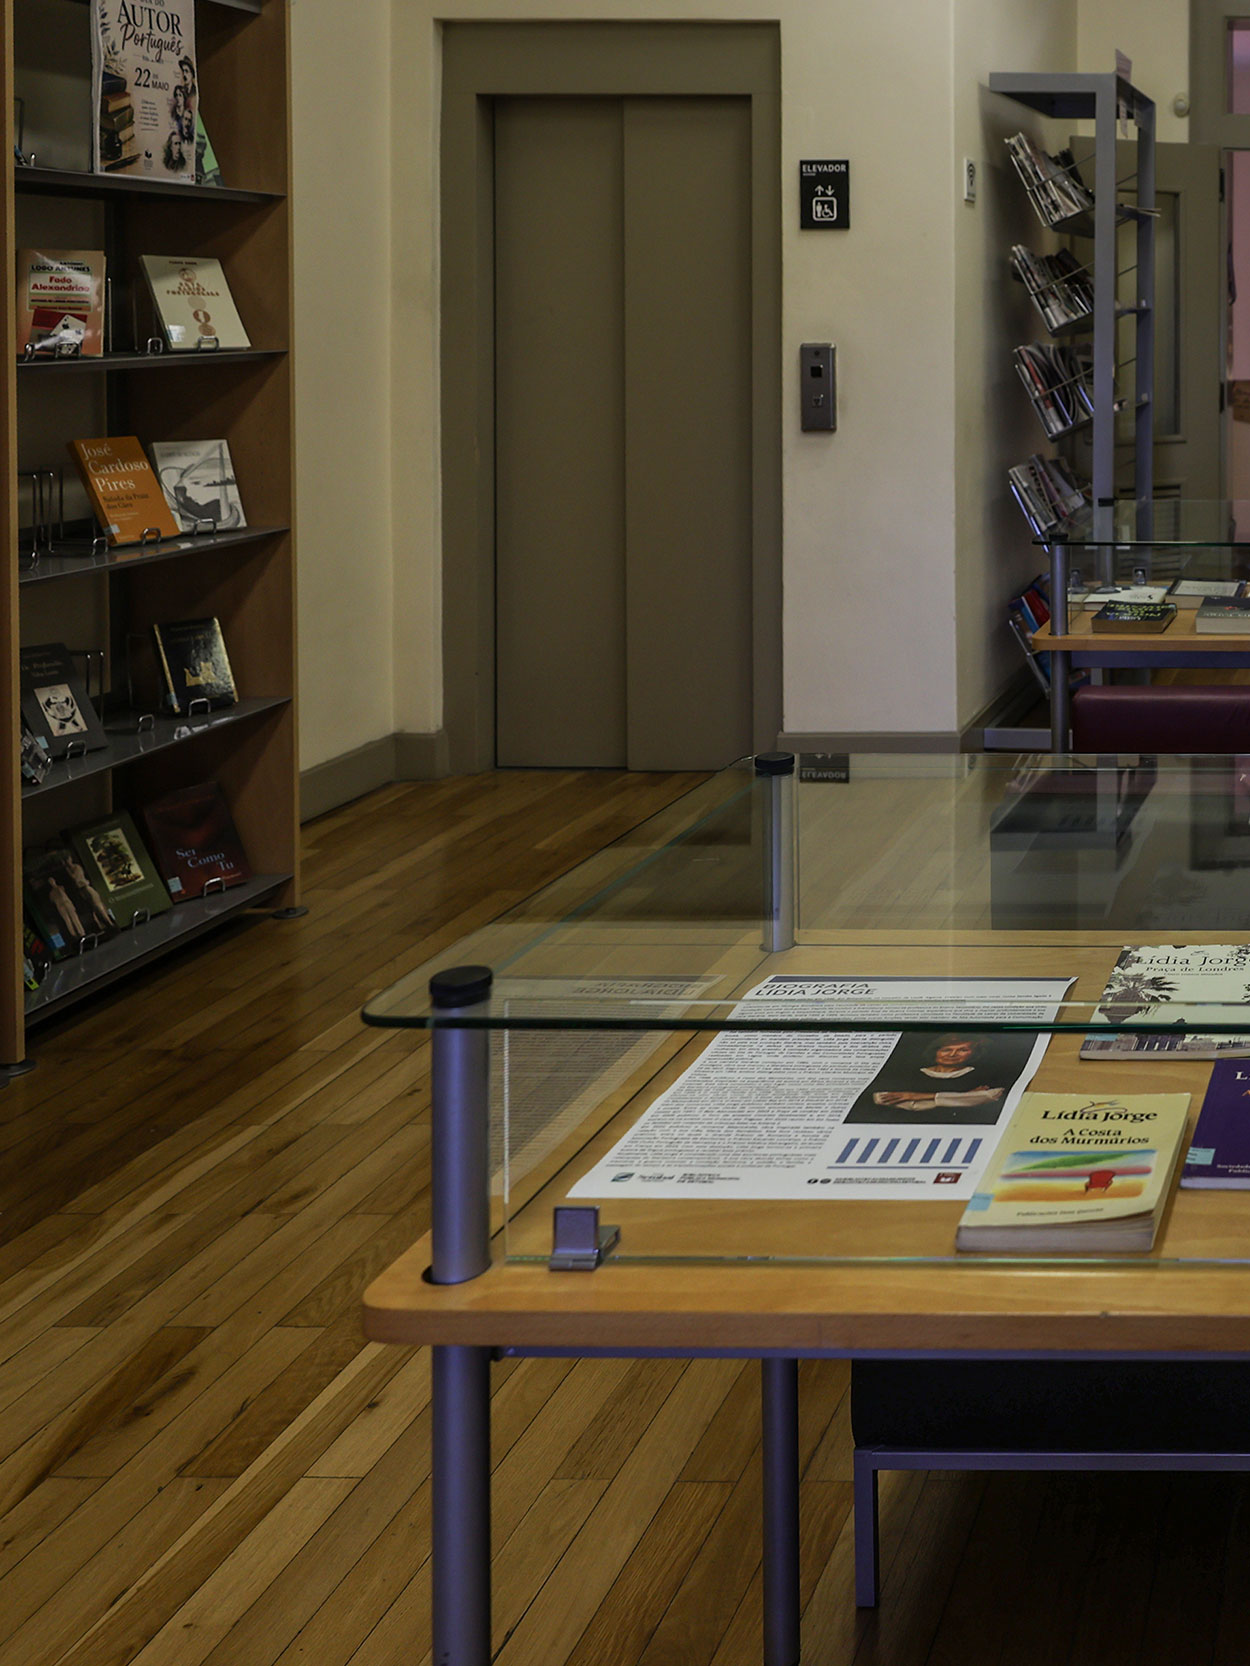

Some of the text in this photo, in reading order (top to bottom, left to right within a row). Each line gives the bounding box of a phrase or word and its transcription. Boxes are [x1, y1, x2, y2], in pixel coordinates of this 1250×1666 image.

[117, 0, 183, 37] AUTOR
[120, 23, 184, 61] Português
[134, 67, 151, 88] 22
[151, 80, 170, 91] MAIO
[802, 163, 847, 173] ELEVADOR
[49, 275, 73, 283] Fado
[31, 283, 90, 293] Alexandrino
[80, 442, 112, 461] José
[88, 458, 149, 475] Cardoso
[94, 477, 136, 493] Pires
[186, 852, 226, 869] Como
[217, 860, 235, 872] Tu
[1136, 955, 1190, 965] Lídia
[762, 982, 871, 990] BIOGRAFIA
[754, 987, 879, 997] LÍDIA JORGE
[1042, 1110, 1159, 1124] Lídia Jorge
[1063, 1128, 1123, 1137] A Costa
[1029, 1136, 1150, 1145] dos Murmúrios
